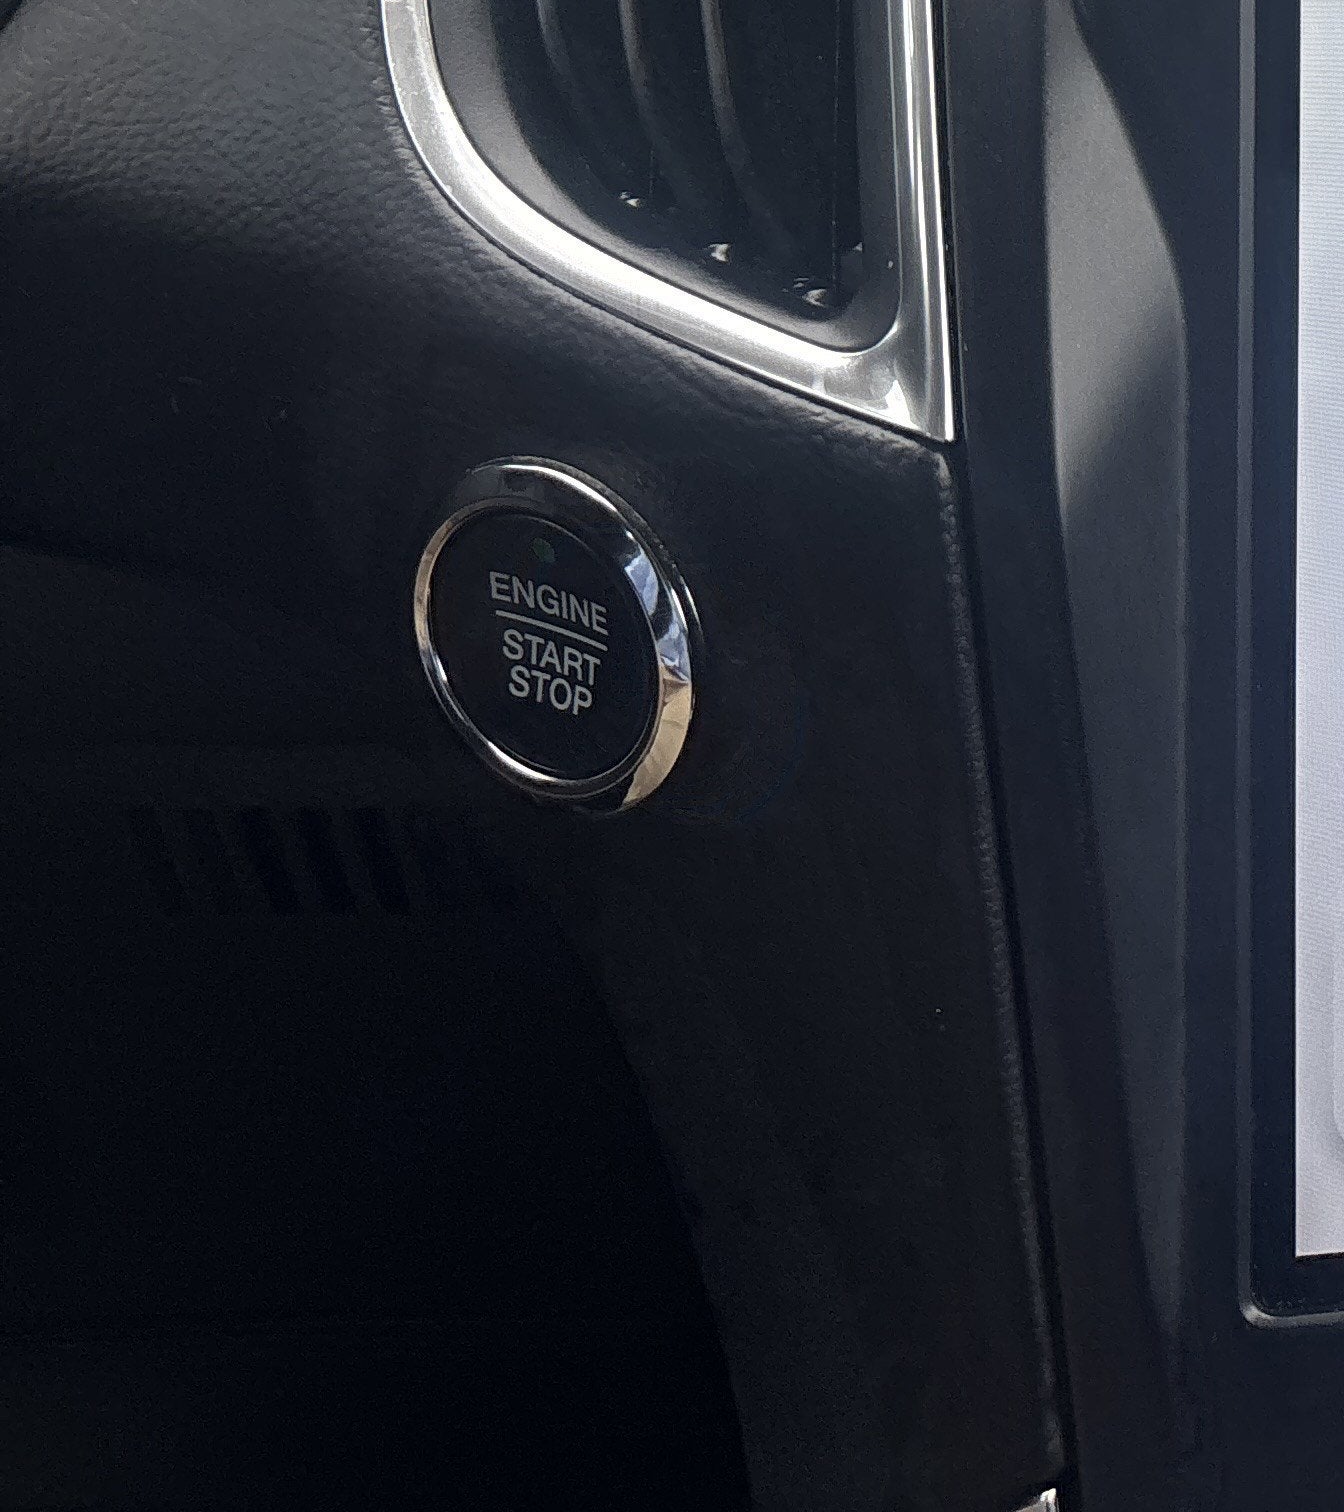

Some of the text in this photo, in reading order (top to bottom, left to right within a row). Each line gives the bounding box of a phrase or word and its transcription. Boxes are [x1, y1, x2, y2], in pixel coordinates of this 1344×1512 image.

[489, 571, 609, 636] ENGINE
[503, 628, 601, 686] START
[509, 664, 593, 716] STOP
